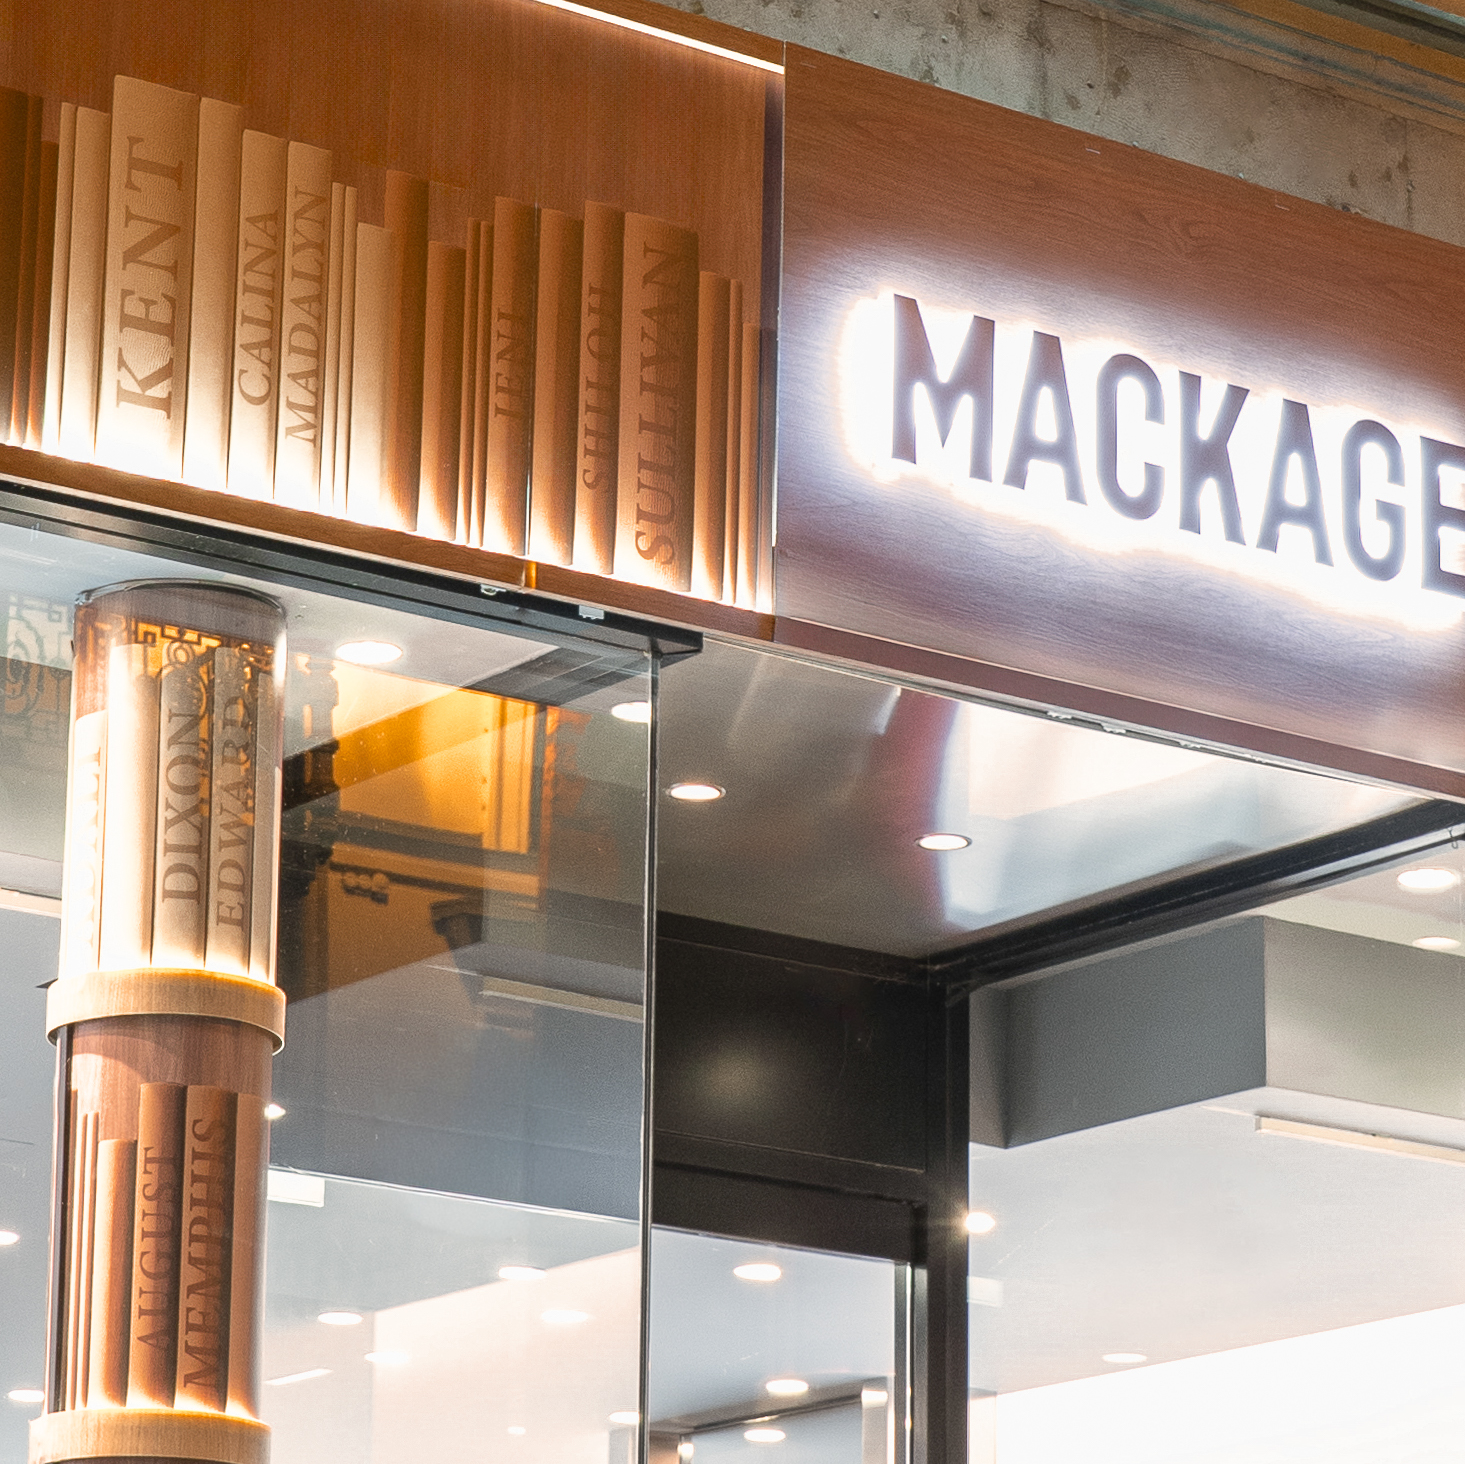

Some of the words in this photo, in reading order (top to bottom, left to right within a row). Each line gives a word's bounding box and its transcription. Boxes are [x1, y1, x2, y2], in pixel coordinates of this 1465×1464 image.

[115, 135, 183, 419] KENT
[238, 208, 278, 407] CALINA
[285, 185, 326, 448] MADALYN
[582, 283, 615, 493] SHILOH
[635, 241, 685, 566] SULLIVAN
[160, 710, 205, 904] DIXON
[215, 696, 252, 932] EDWARD
[137, 1147, 176, 1353] AUGUST
[183, 1118, 226, 1391] MEMPHIS
